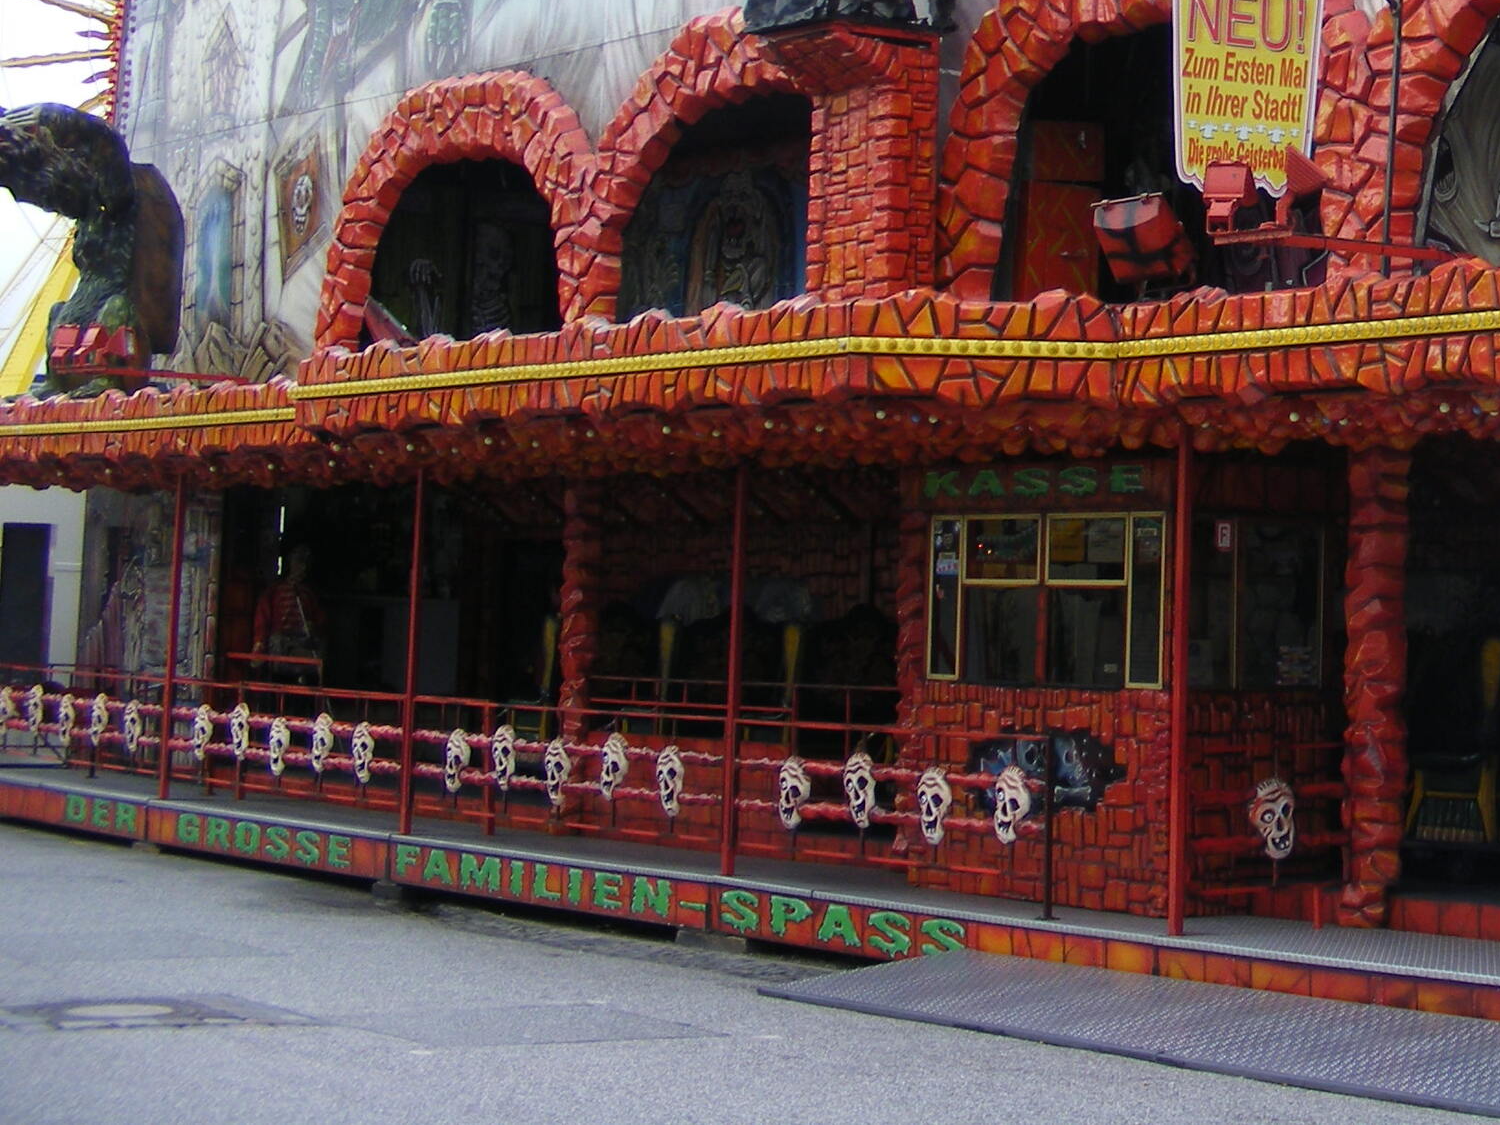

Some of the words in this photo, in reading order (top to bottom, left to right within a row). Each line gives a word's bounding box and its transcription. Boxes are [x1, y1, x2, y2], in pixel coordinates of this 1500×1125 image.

[1182, 47, 1219, 79] Zum
[1223, 51, 1275, 86] Ersten
[1279, 58, 1308, 90] Mal
[1185, 85, 1202, 115] in
[1205, 86, 1249, 119] Ihrer
[1252, 89, 1303, 123] Stadt!
[1187, 137, 1204, 167] Die
[1236, 141, 1287, 171] Geisterba
[922, 464, 1145, 499] KASSE
[65, 794, 138, 834] DER
[177, 813, 351, 869] GROSSE
